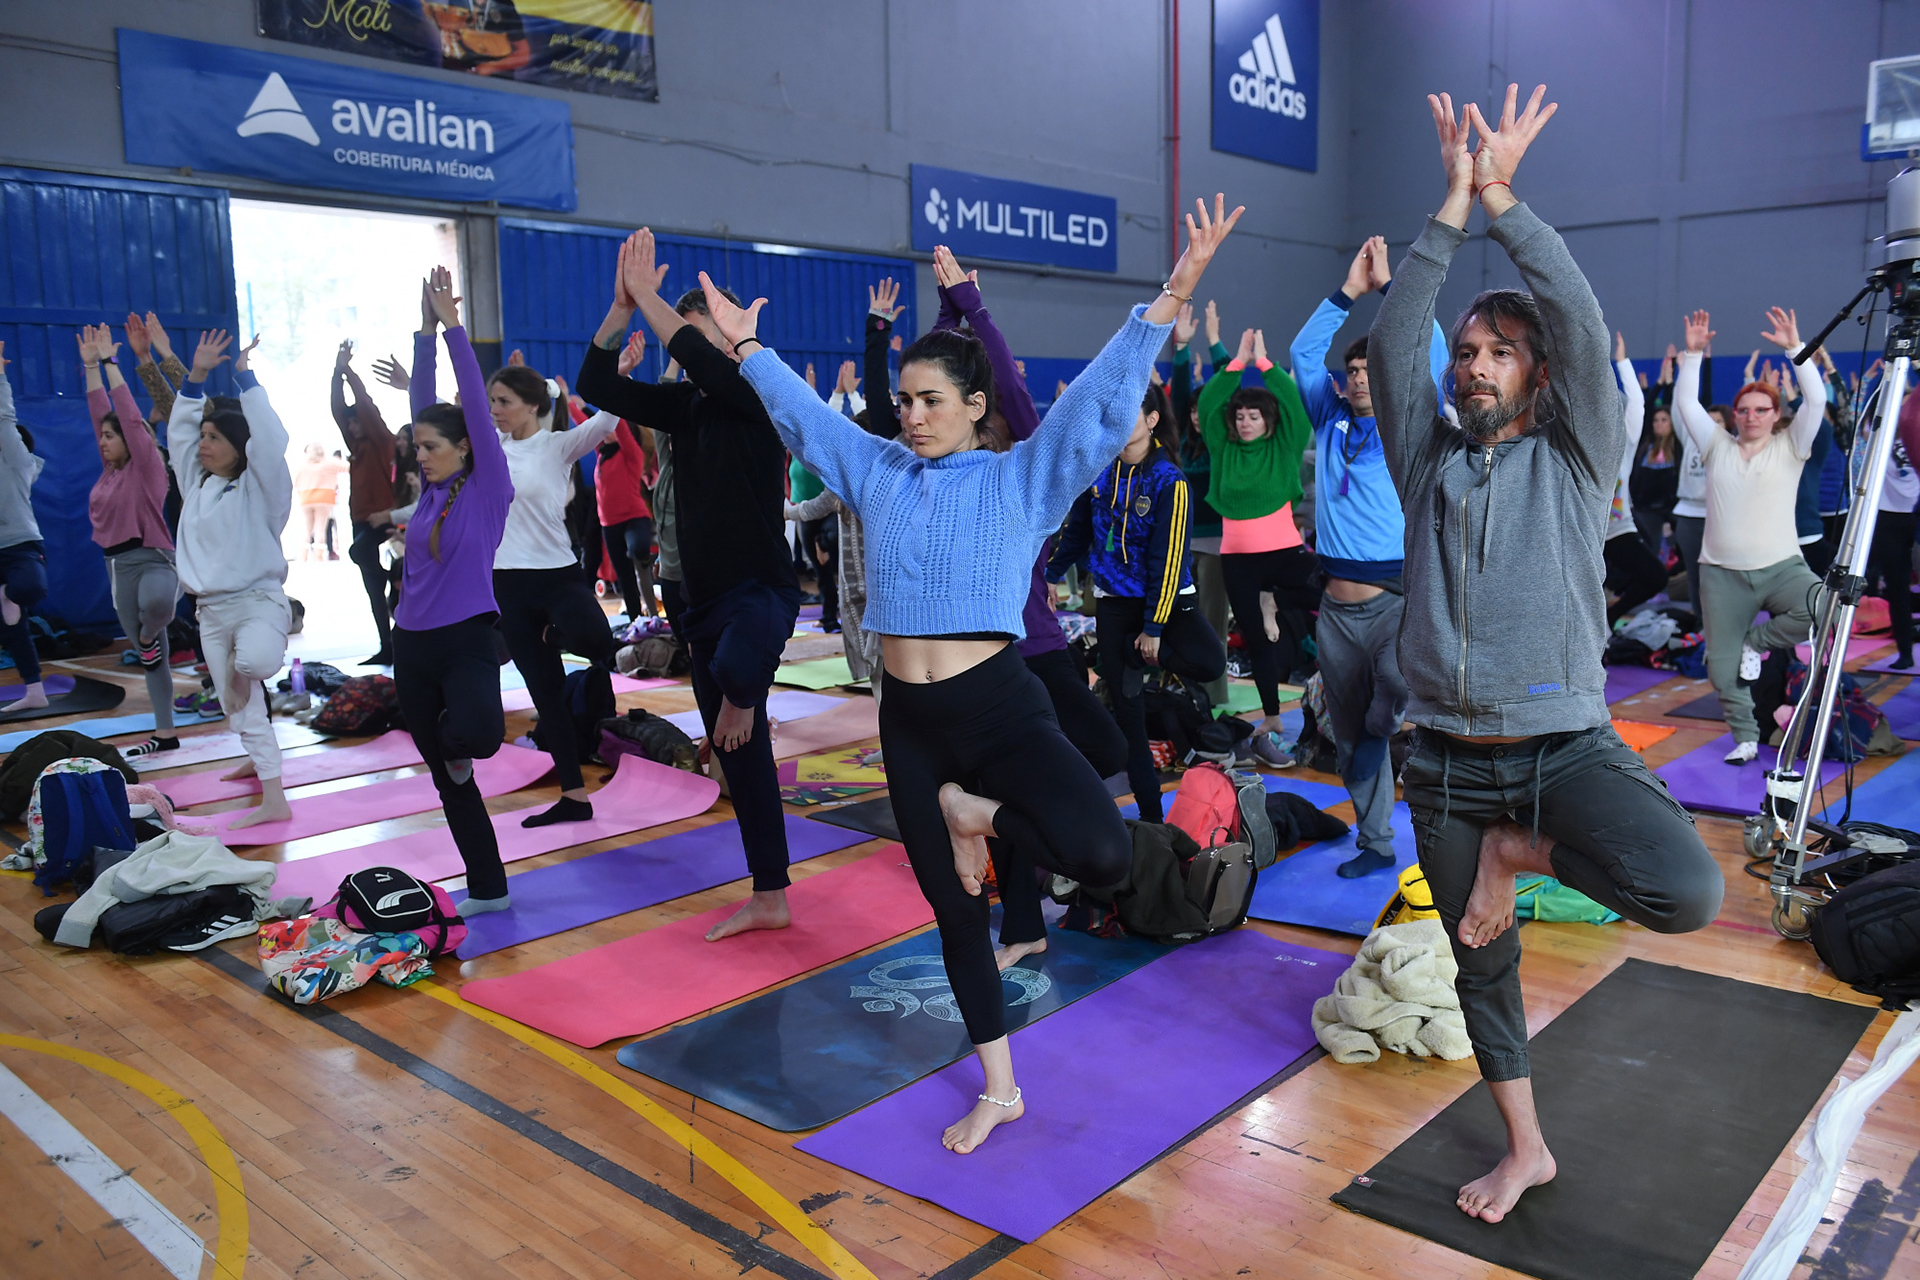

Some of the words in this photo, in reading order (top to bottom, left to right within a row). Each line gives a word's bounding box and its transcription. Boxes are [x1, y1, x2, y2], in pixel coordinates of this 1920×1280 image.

[1229, 71, 1307, 120] adidas
[331, 98, 495, 154] avalian
[333, 148, 434, 175] COBERTURA
[435, 159, 495, 182] MÉDICA
[957, 197, 1109, 248] MULTILED
